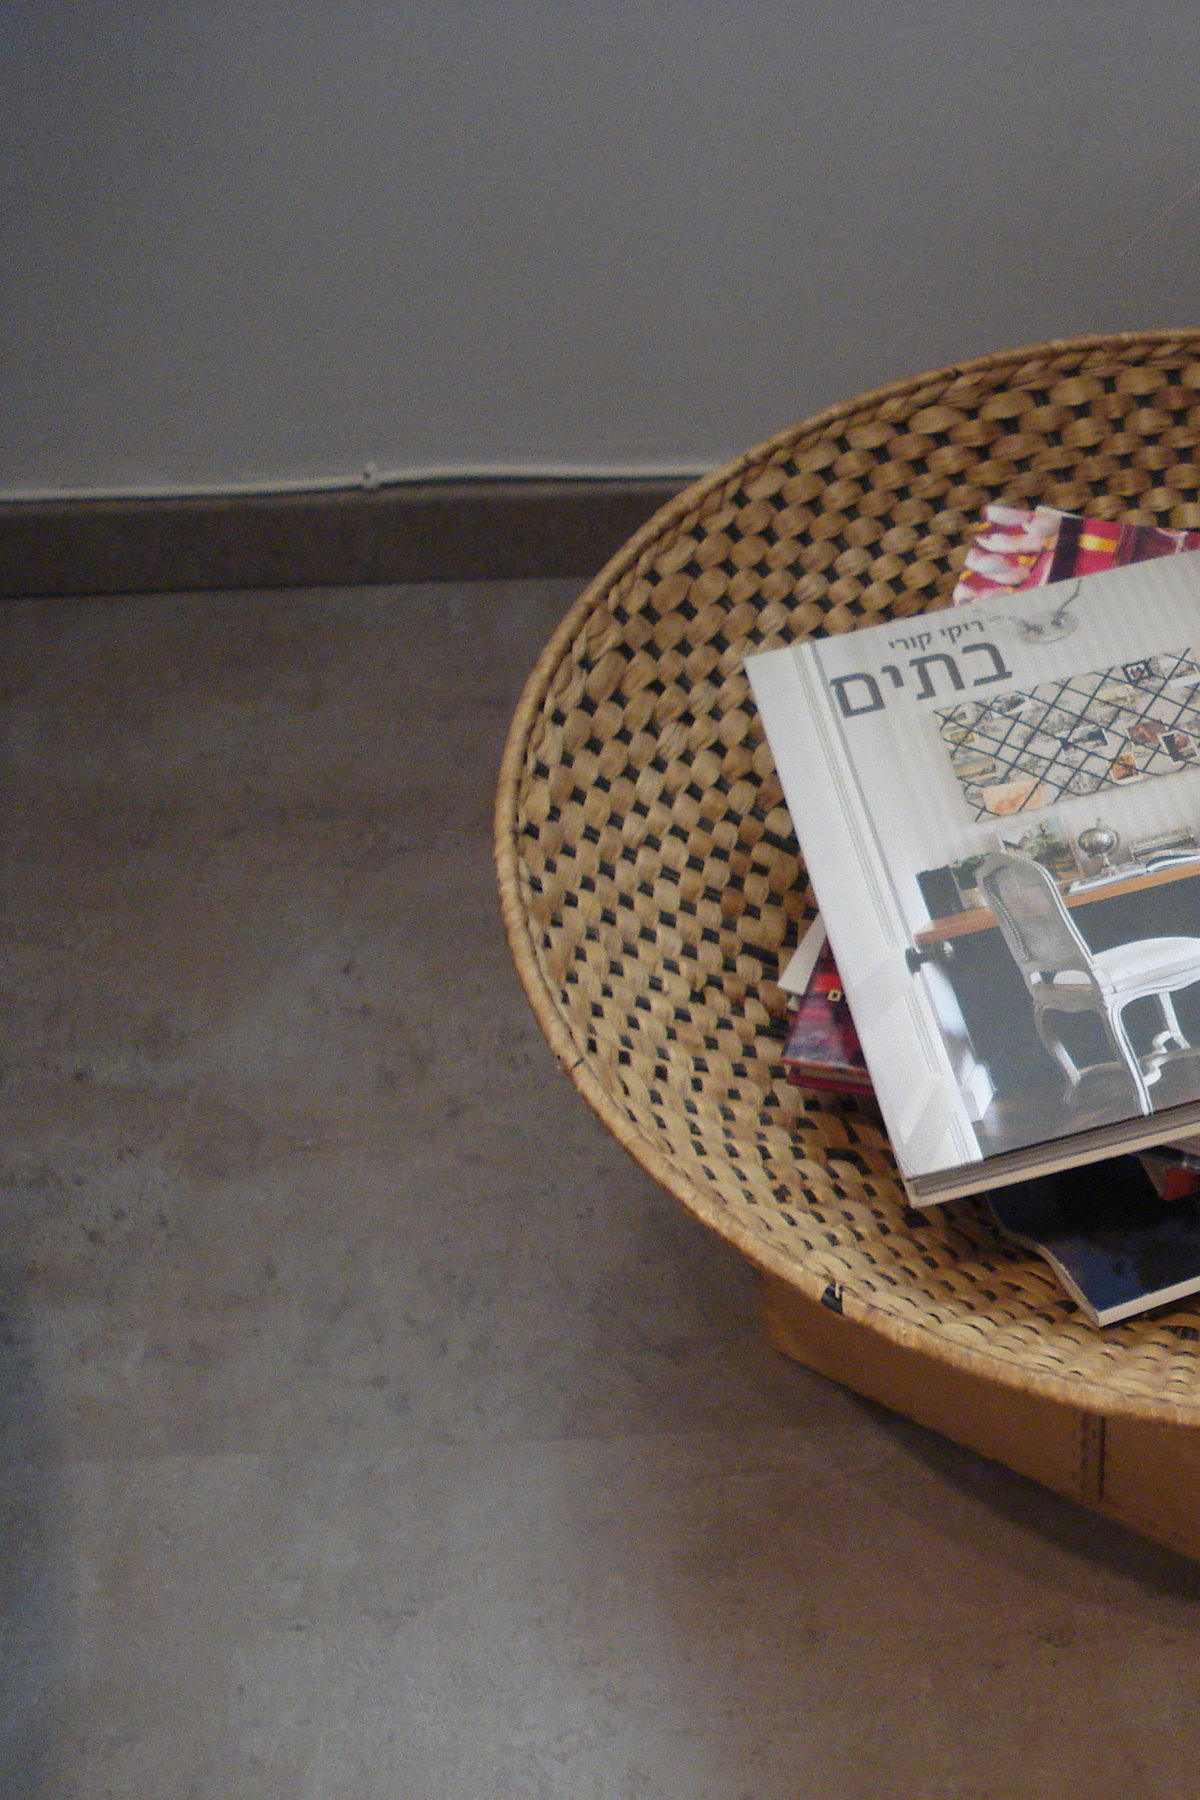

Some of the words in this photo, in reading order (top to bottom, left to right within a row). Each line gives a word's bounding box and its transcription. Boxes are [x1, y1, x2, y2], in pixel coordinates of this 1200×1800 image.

[887, 631, 932, 651] קורי
[938, 619, 985, 644] ריקי
[829, 641, 1013, 719] בתים
